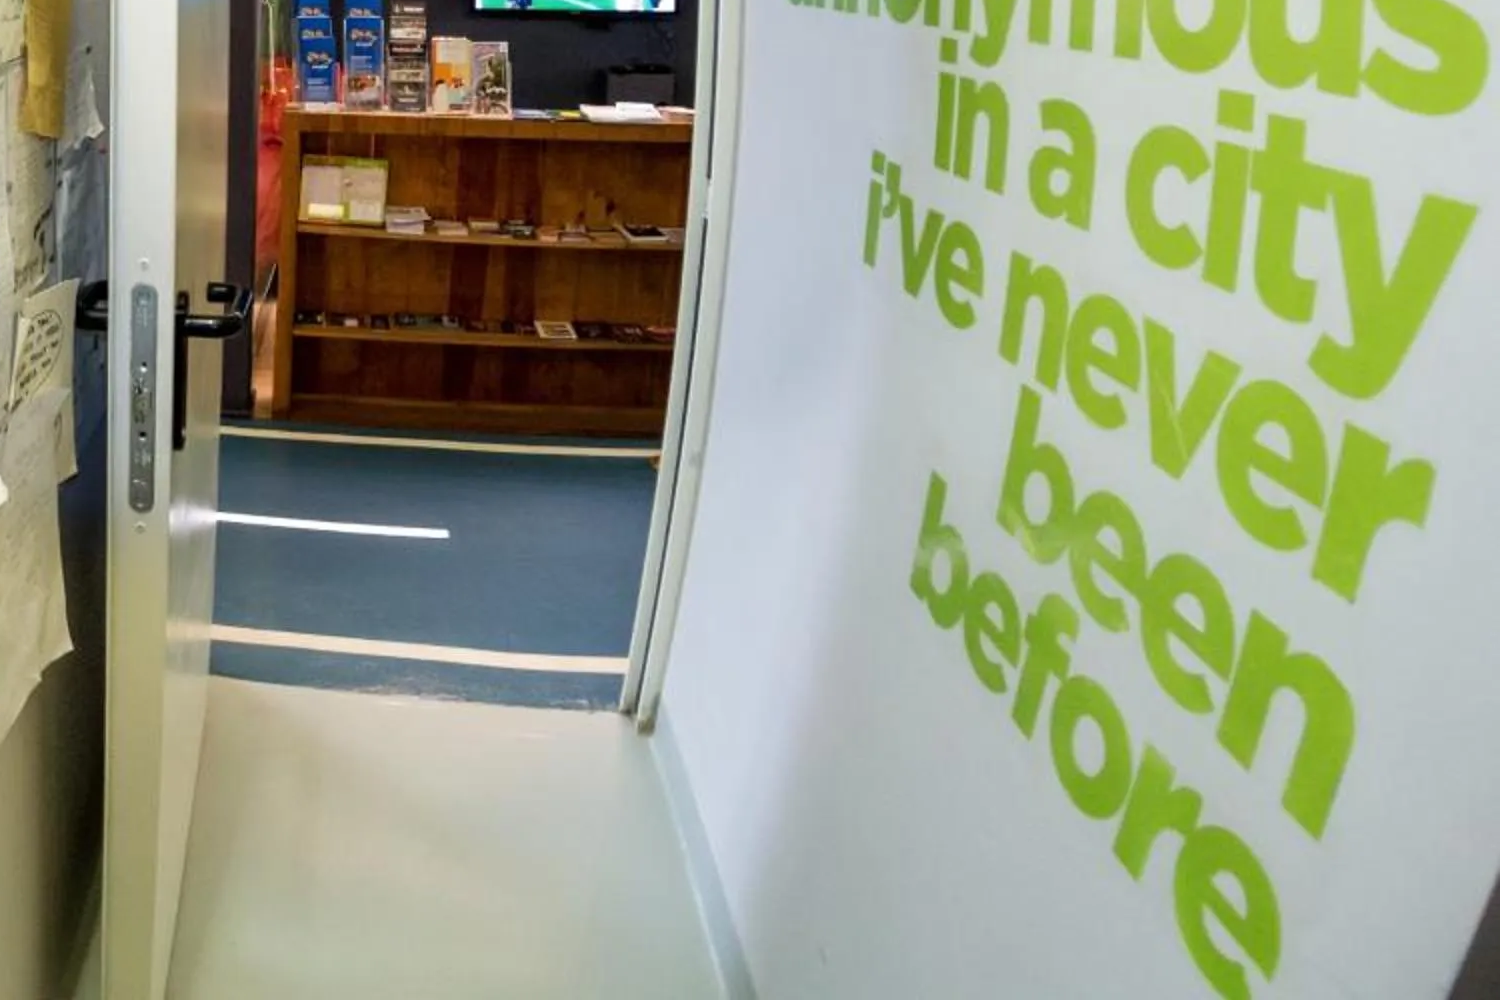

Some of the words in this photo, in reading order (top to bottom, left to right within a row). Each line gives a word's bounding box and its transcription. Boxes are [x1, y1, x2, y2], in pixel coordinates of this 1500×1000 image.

[864, 149, 984, 329] i've
[998, 250, 1436, 604] never
[934, 37, 1010, 196] in
[1028, 98, 1097, 232] a
[1125, 88, 1480, 400] city
[910, 470, 1281, 1000] before
[996, 383, 1356, 842] been
